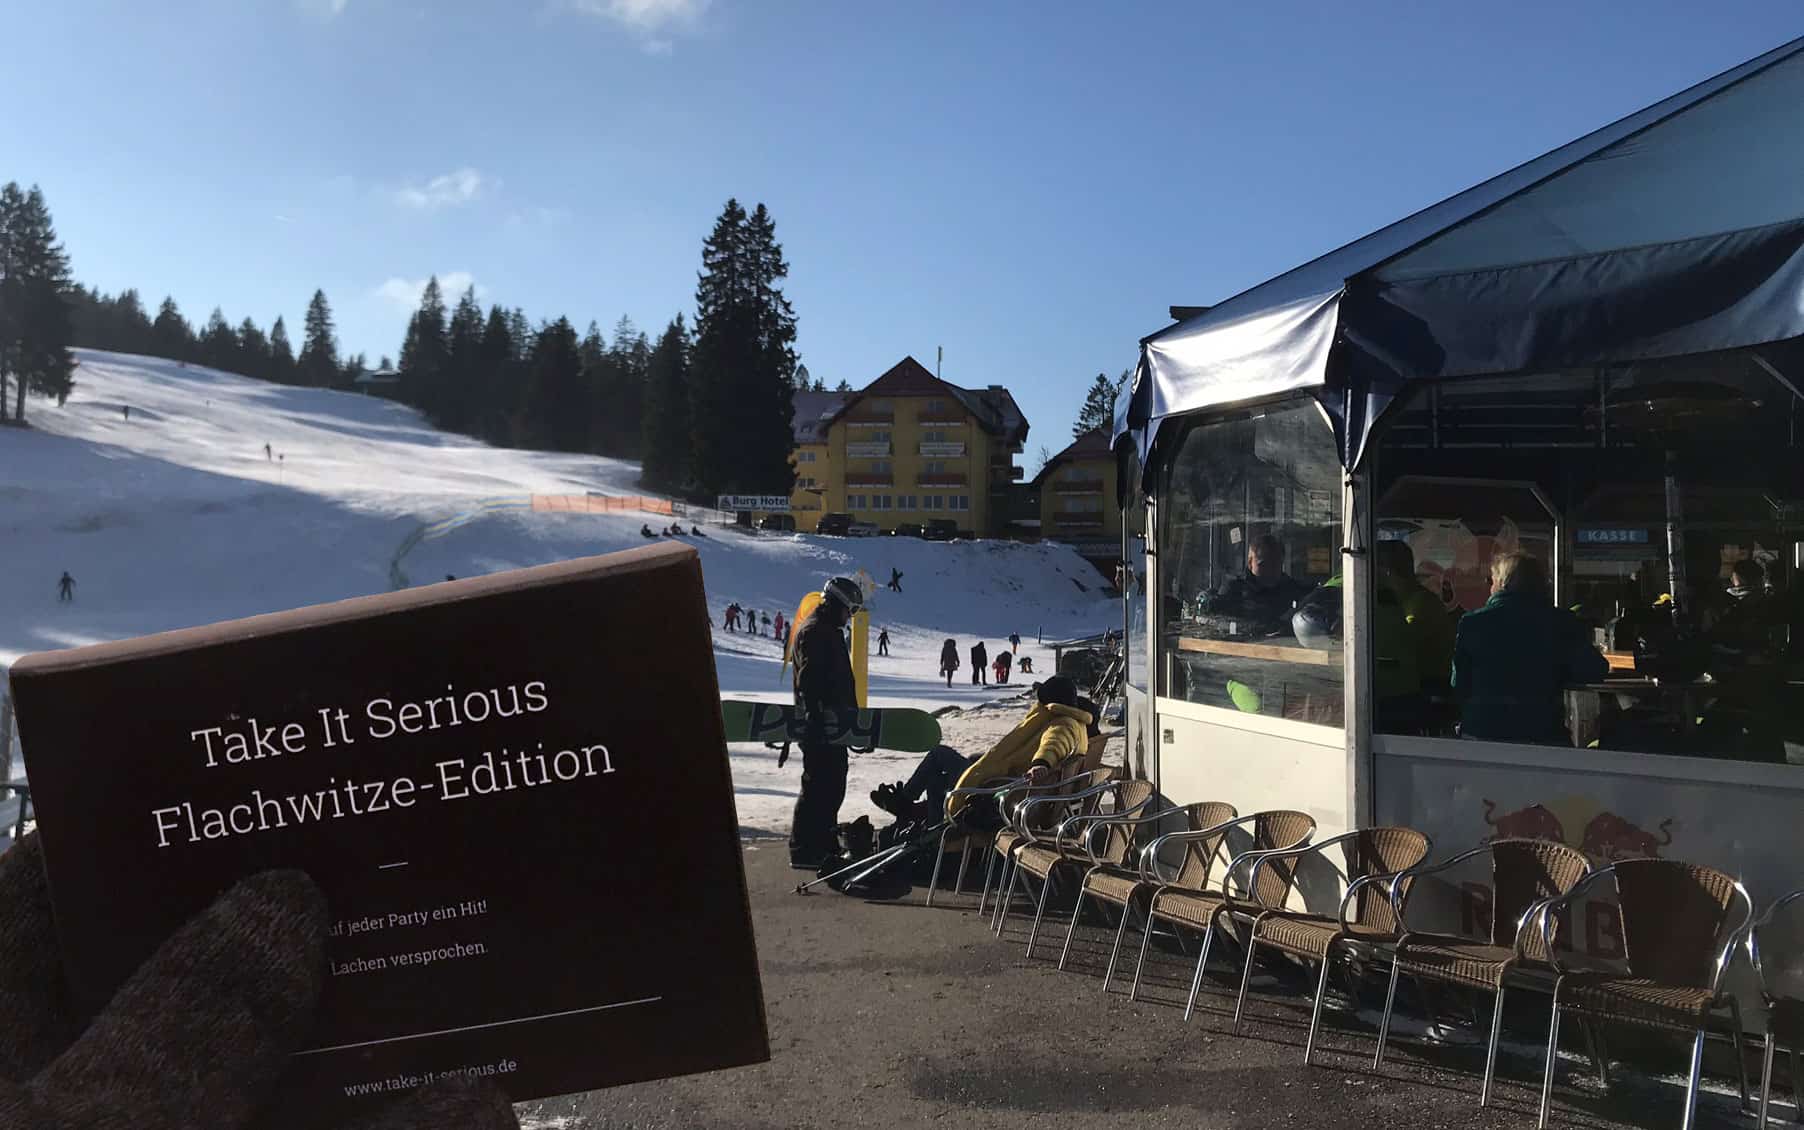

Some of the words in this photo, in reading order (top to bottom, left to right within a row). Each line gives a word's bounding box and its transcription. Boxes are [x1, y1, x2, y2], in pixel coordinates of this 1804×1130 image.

[732, 495, 757, 507] Burg
[760, 495, 788, 506] Hotel
[1588, 530, 1637, 541] KASSE
[191, 718, 306, 768] Take
[318, 708, 355, 747] It
[366, 681, 548, 738] Serious
[151, 743, 616, 848] Flachwitze-Edition
[348, 917, 386, 937] jeder
[388, 911, 429, 928] Party
[432, 908, 458, 921] ein
[459, 899, 488, 917] Hit!
[332, 957, 388, 976] Lachen
[390, 943, 488, 966] versprochen.
